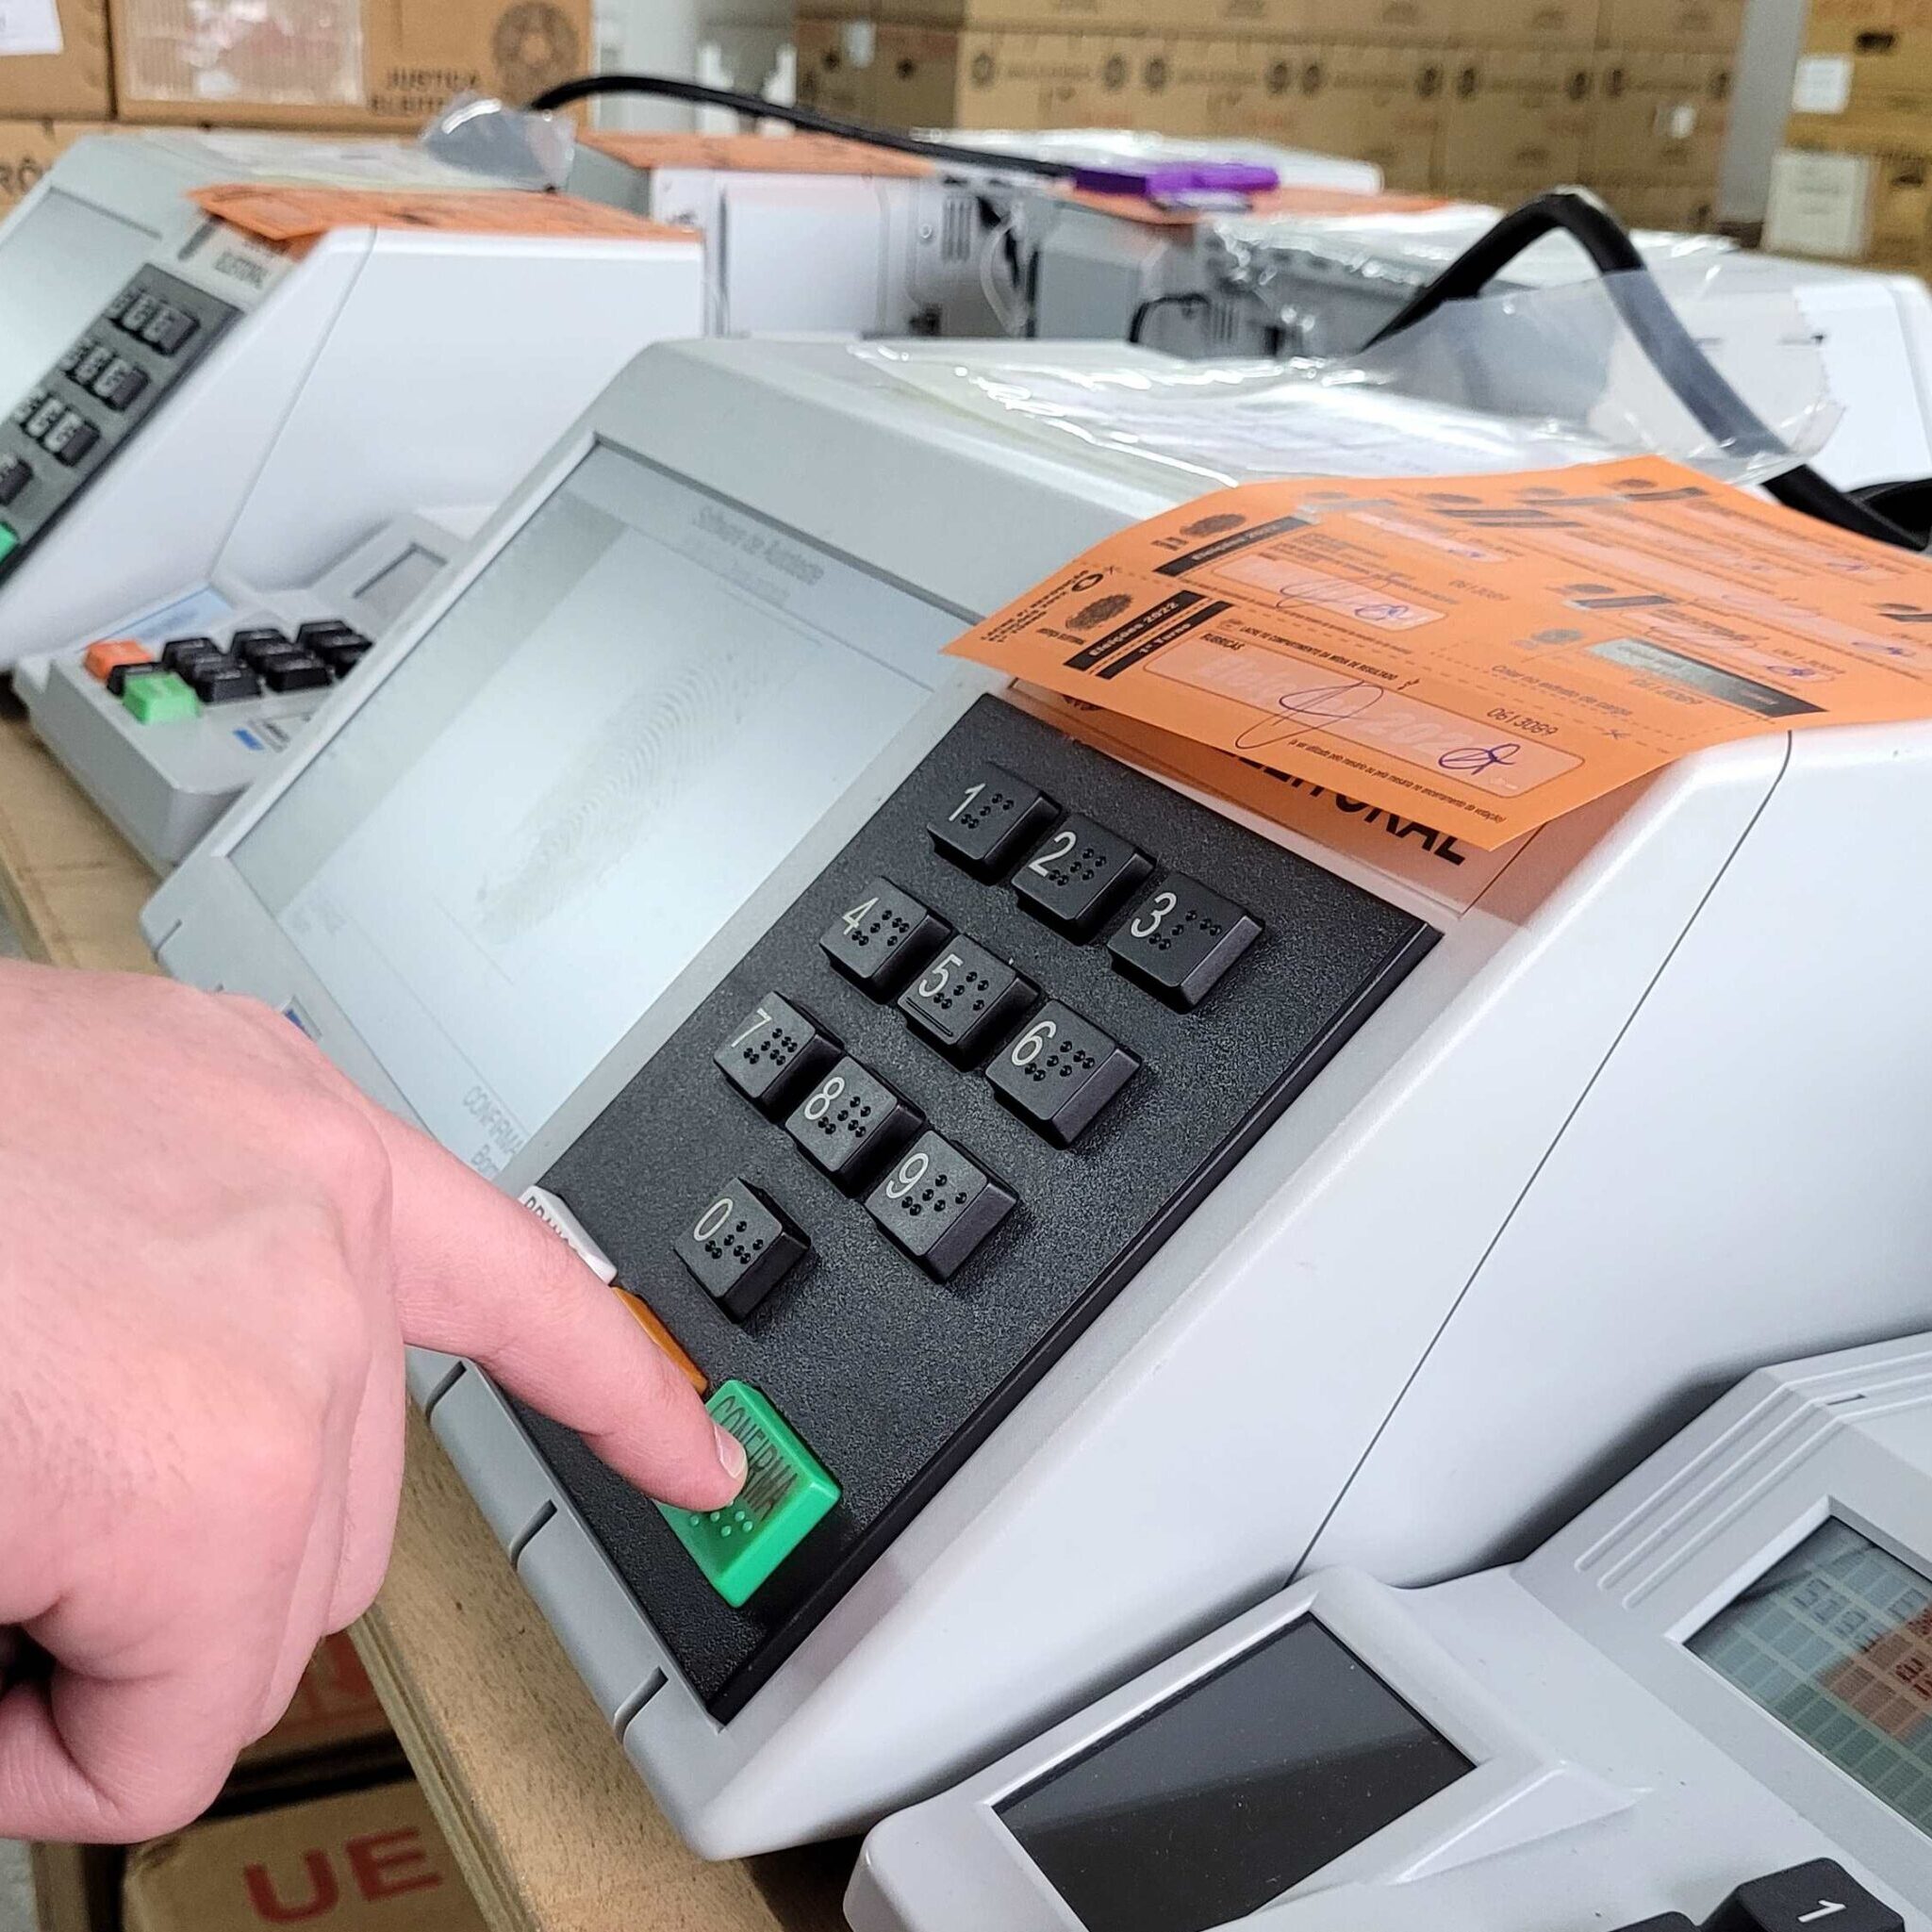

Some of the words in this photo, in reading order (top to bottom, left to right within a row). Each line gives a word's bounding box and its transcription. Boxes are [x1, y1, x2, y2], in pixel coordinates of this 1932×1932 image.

[1088, 622, 1145, 656] Eleições
[949, 783, 986, 822] 1
[1028, 831, 1078, 878] 2
[842, 897, 880, 935] 4
[1130, 892, 1178, 937] 3
[917, 953, 963, 999] 5
[731, 1008, 773, 1049] 7
[1010, 1020, 1057, 1066] 6
[803, 1076, 846, 1120] 8
[885, 1152, 930, 1199] 9
[243, 1826, 445, 1924] UE
[1798, 1899, 1847, 1924] 1
